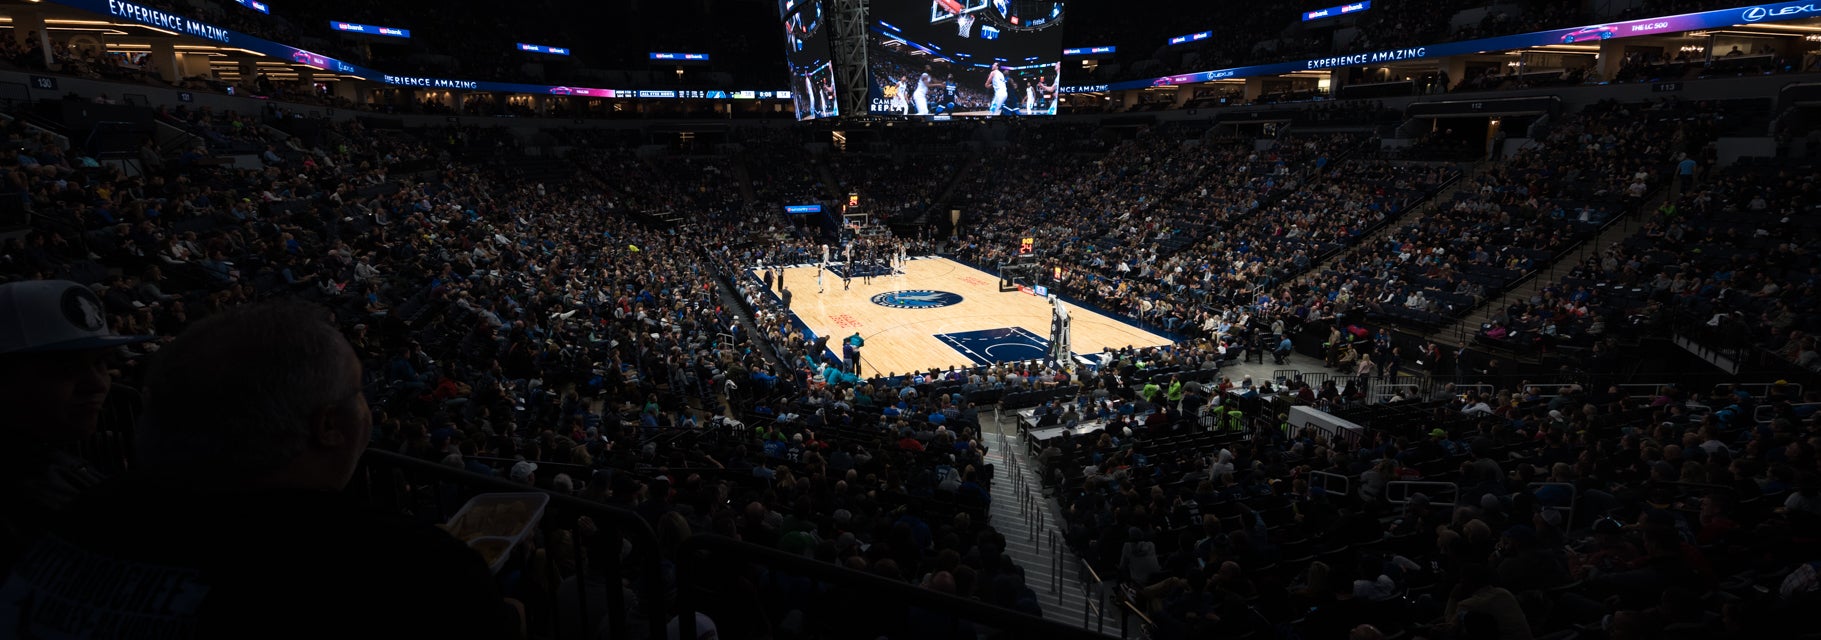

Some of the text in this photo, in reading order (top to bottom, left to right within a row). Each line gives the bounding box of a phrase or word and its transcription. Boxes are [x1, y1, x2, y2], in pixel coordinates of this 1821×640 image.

[109, 0, 230, 43] EXPERIENCE AMAZING
[1032, 18, 1045, 26] fitbit
[1307, 47, 1426, 70] EXPERIENCE AMAZING
[37, 77, 53, 89] 130
[434, 79, 477, 89] AMAZING
[1019, 243, 1032, 254] 24
